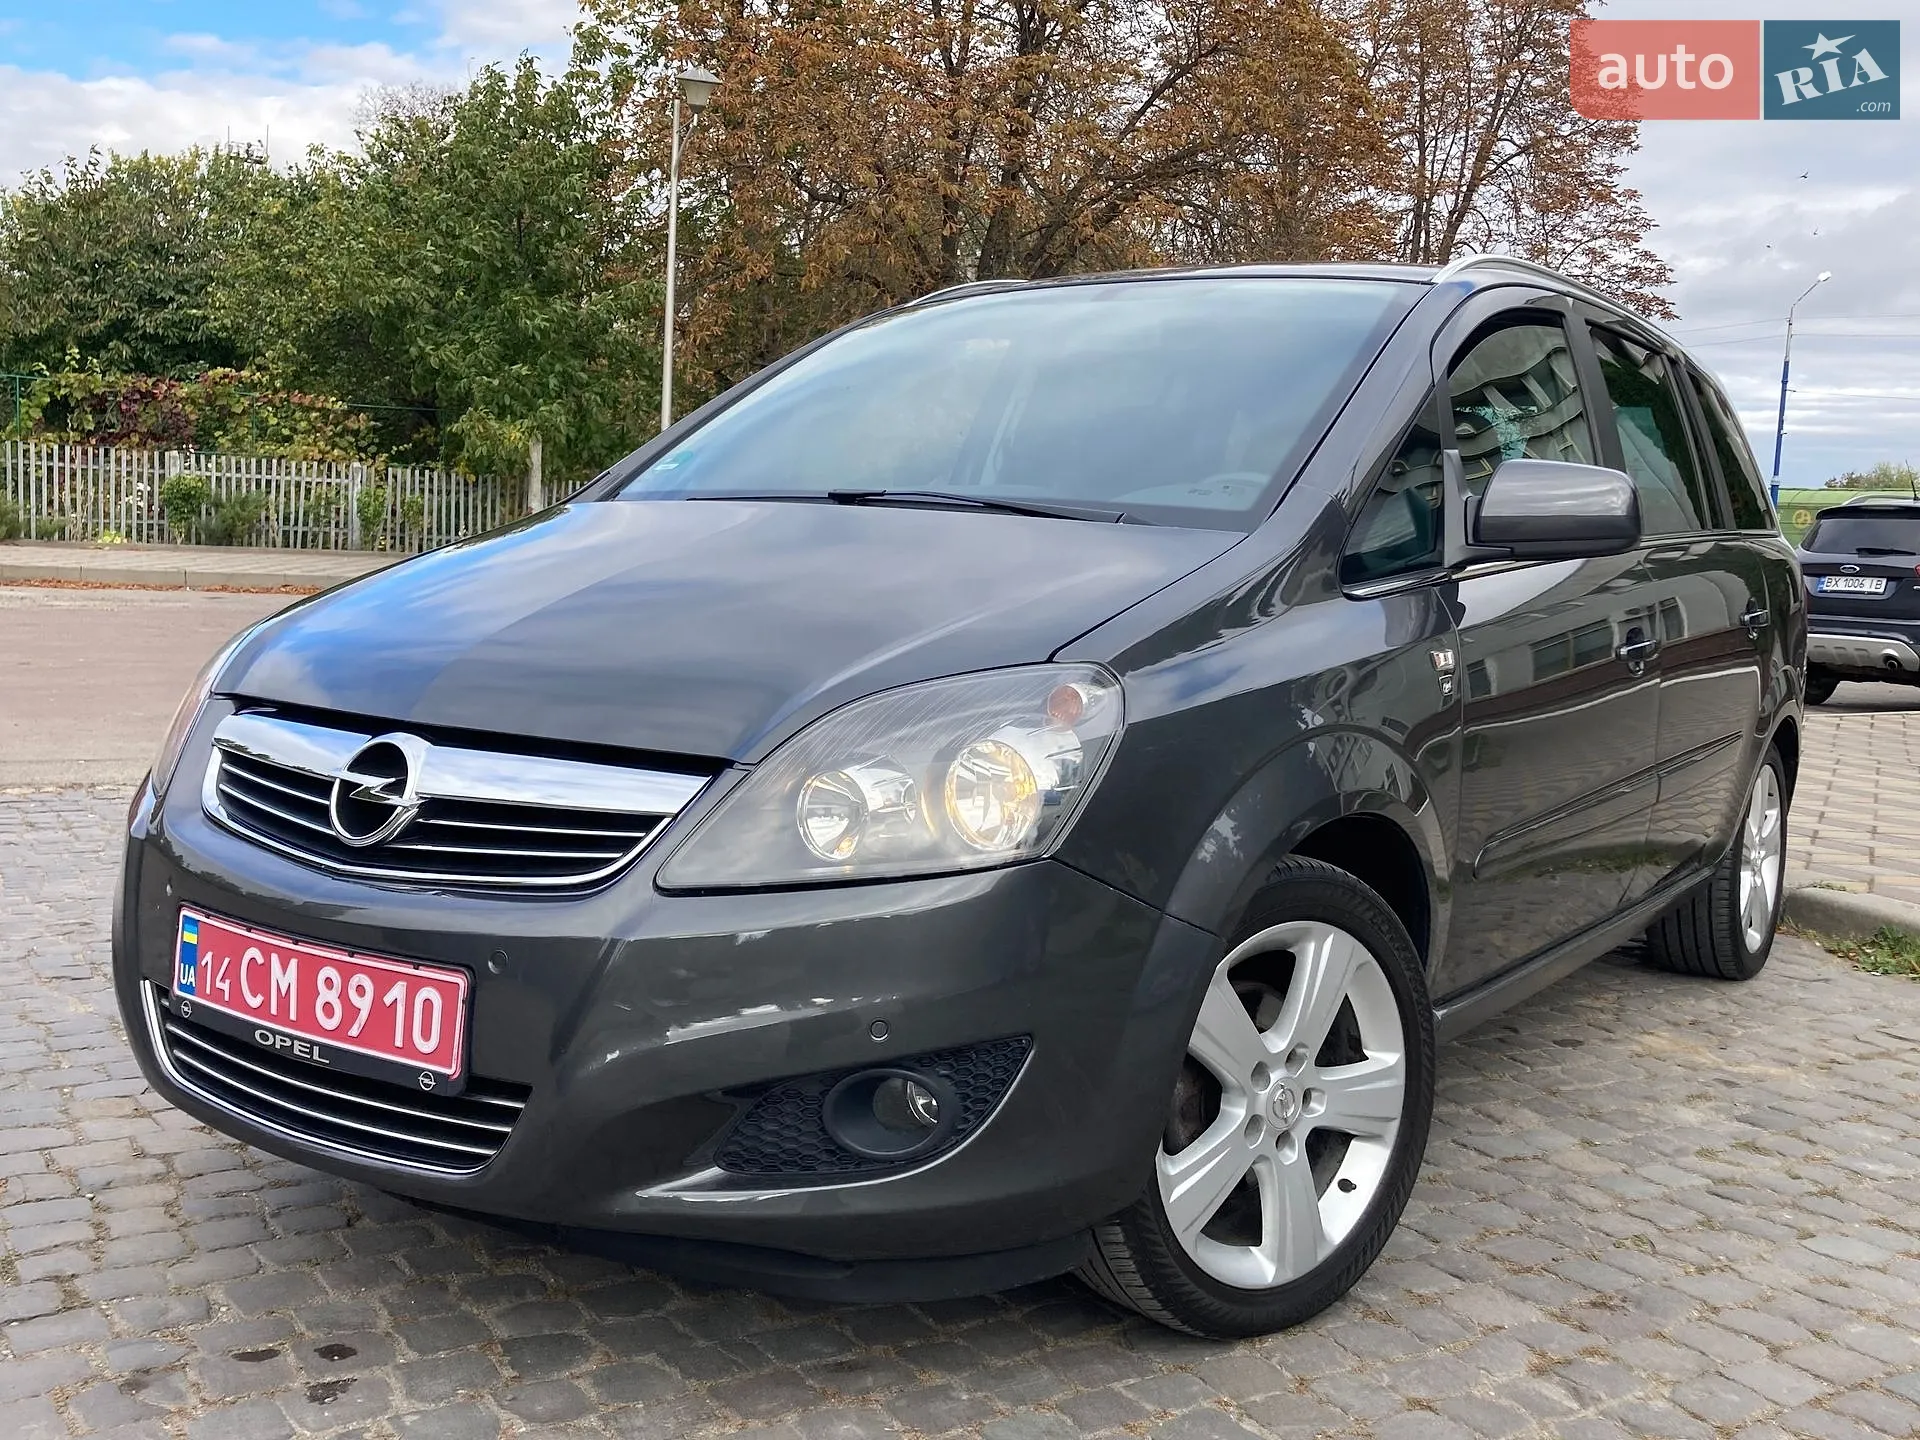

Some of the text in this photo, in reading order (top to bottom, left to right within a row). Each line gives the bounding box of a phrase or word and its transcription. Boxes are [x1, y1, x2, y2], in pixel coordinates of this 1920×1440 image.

[180, 962, 196, 988] UA
[314, 966, 443, 1054] 8910
[254, 1029, 331, 1065] OPEL
